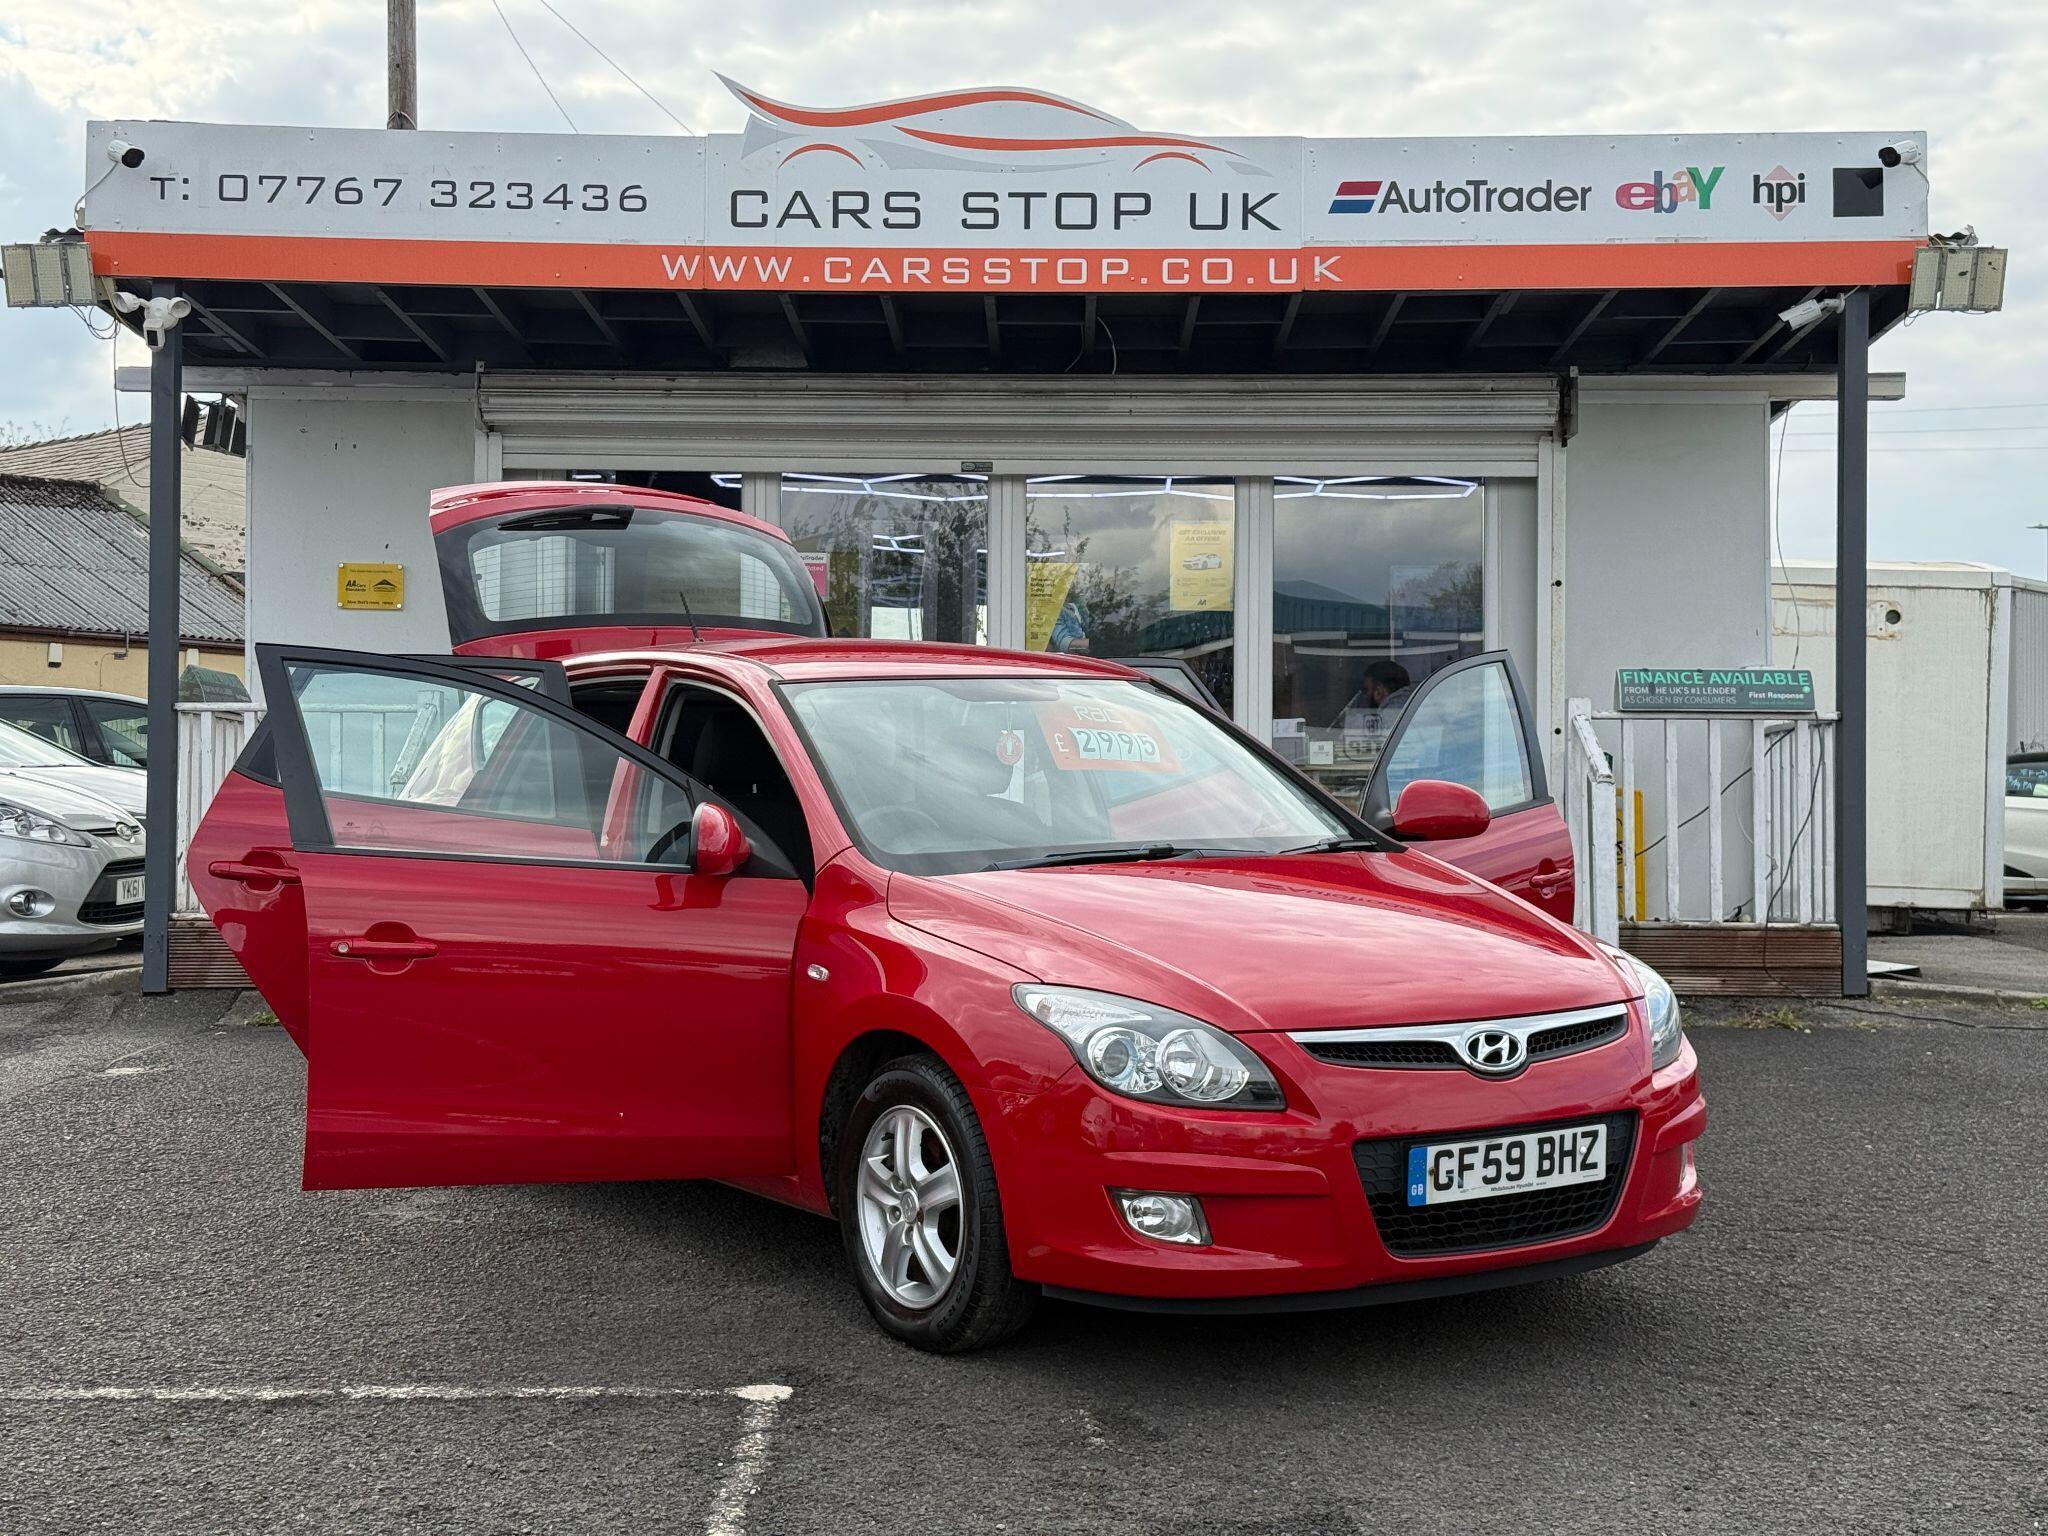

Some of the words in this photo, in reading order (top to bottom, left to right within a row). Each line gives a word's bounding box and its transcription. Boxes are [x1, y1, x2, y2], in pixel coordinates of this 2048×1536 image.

[150, 176, 190, 201] T:
[218, 174, 403, 206] 07767
[430, 180, 648, 213] 323436
[1378, 179, 1592, 214] AutoTrader
[1753, 173, 1806, 213] hpi
[730, 190, 921, 230] CARS
[961, 191, 1151, 230] STOP
[1189, 192, 1282, 231] UK
[661, 254, 1344, 285] WWW.CARSSTOP.CO.UK
[1622, 671, 1704, 684] FINANCE
[1709, 672, 1810, 686] AVAILABLE
[1624, 686, 1649, 694] FROM
[1702, 687, 1736, 695] LENDER
[1624, 696, 1635, 704] AS
[1636, 695, 1671, 704] CHOSEN
[1673, 696, 1683, 704] BY
[1684, 696, 1737, 704] CONSUMERS
[1767, 692, 1804, 700] Response
[1054, 732, 1070, 752] £
[1076, 730, 1157, 756] 2995
[1433, 1140, 1526, 1191] GF59
[1536, 1129, 1600, 1178] BHZ
[1411, 1183, 1424, 1196] GB
